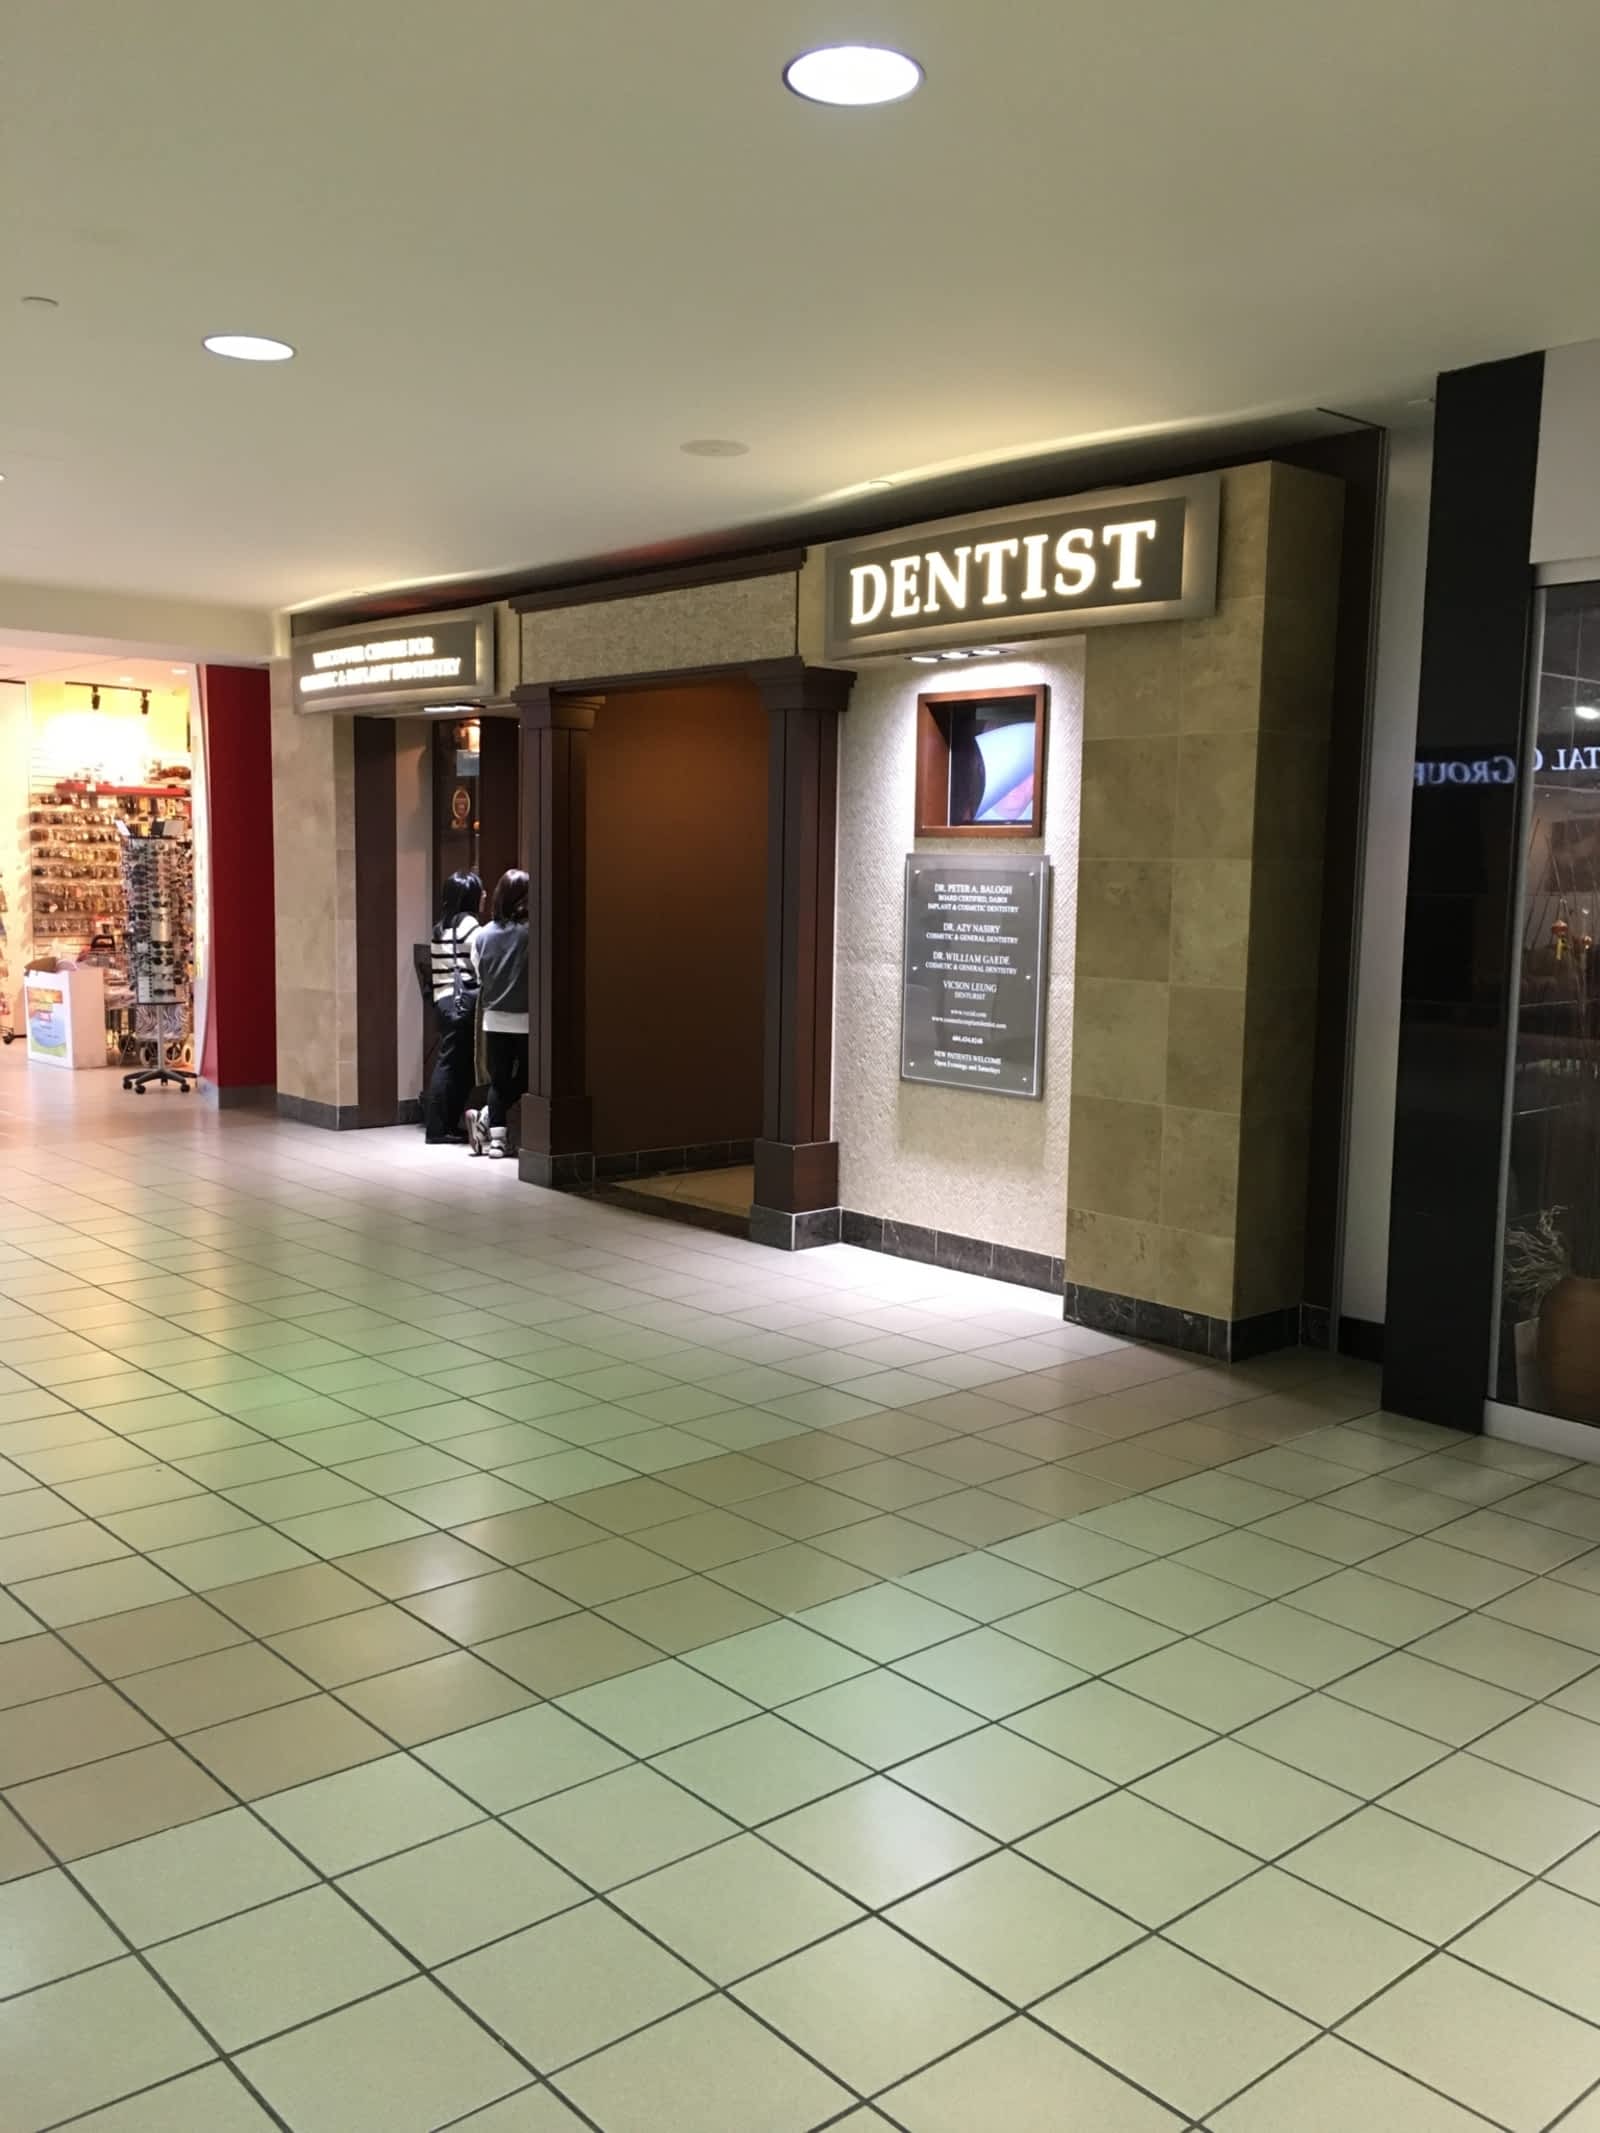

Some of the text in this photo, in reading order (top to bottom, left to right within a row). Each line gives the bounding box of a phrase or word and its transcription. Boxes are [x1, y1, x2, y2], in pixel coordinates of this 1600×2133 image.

[850, 519, 1156, 625] DENTIST
[934, 883, 946, 893] DR.
[947, 883, 970, 893] PETER
[980, 885, 1013, 895] BALOGH
[986, 905, 1019, 913] DENTISTRY
[943, 922, 955, 932] DR.
[986, 935, 1019, 944] DENTISTRY
[933, 951, 944, 961] DR.
[945, 951, 982, 964] WILLIAM
[985, 966, 1017, 975] DENTISTRY
[943, 980, 997, 993] VICSON LEUNG
[972, 1055, 1001, 1065] WELCOME
